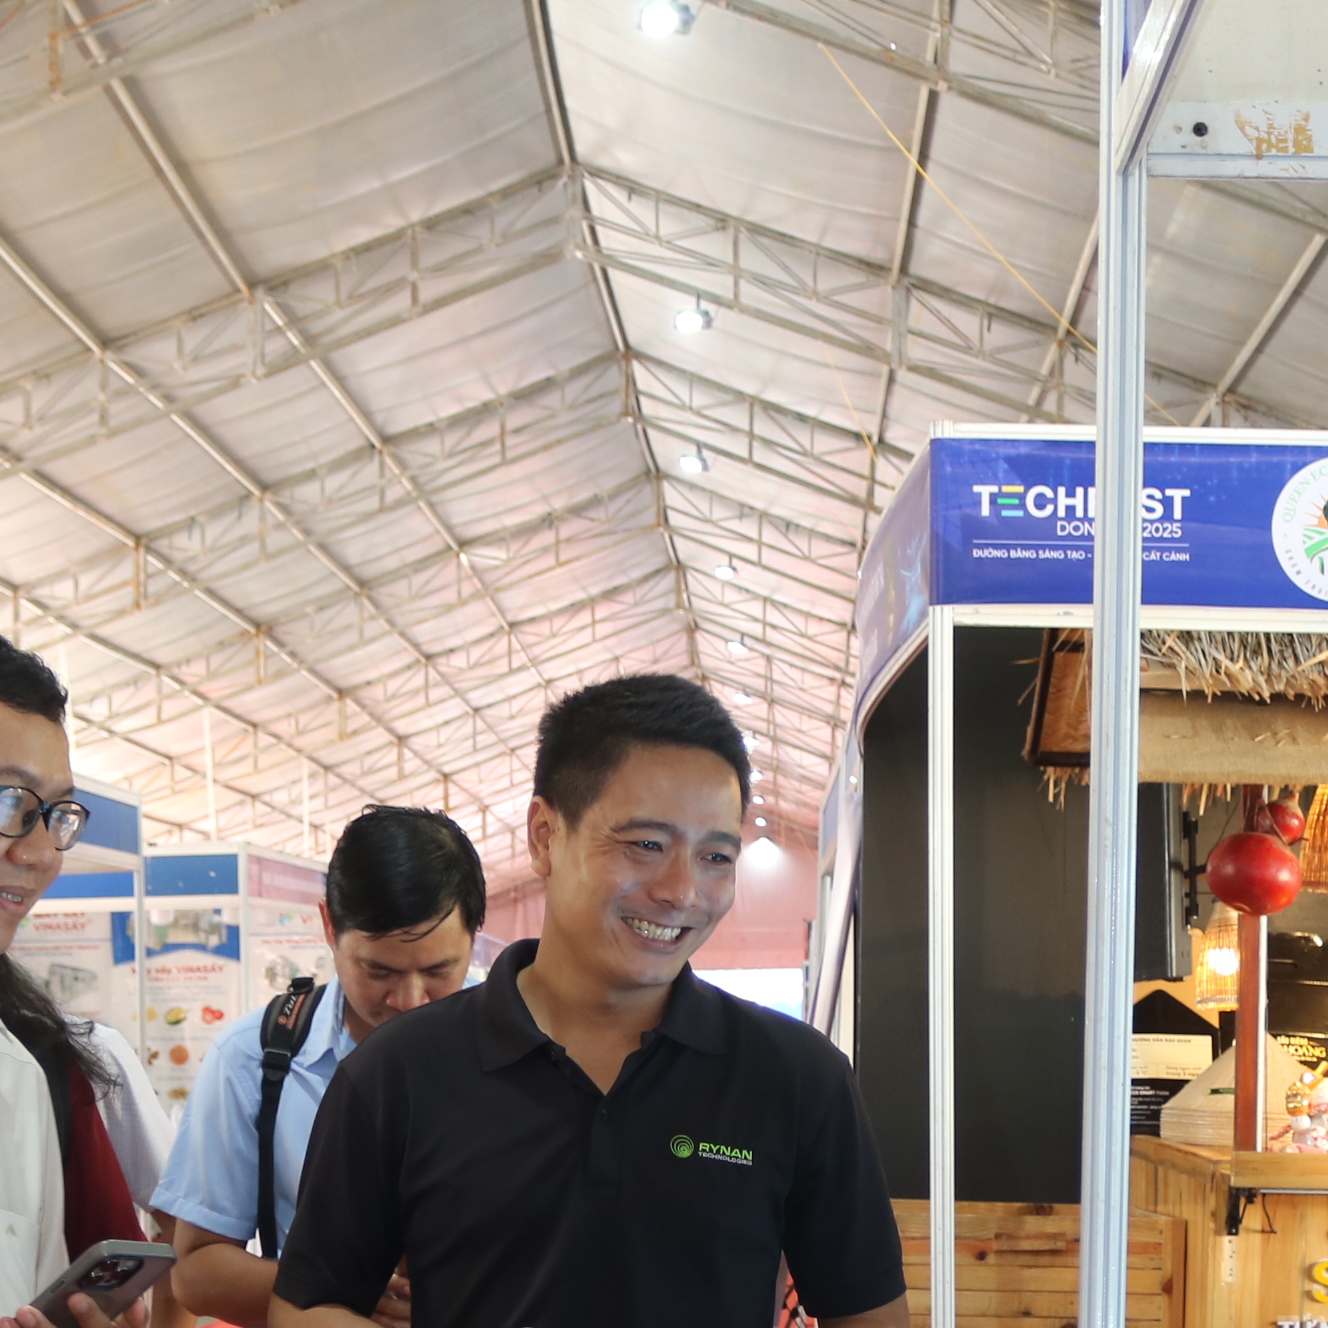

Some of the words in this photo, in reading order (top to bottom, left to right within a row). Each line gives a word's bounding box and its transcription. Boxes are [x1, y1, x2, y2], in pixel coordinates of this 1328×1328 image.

[972, 485, 1191, 520] TECHST
[1282, 475, 1312, 523] QUEEN
[1142, 522, 1182, 538] 2025
[1066, 550, 1086, 561] TẠO
[698, 1151, 753, 1166] TECHNOLOGIES
[699, 1142, 753, 1161] RYNAN
